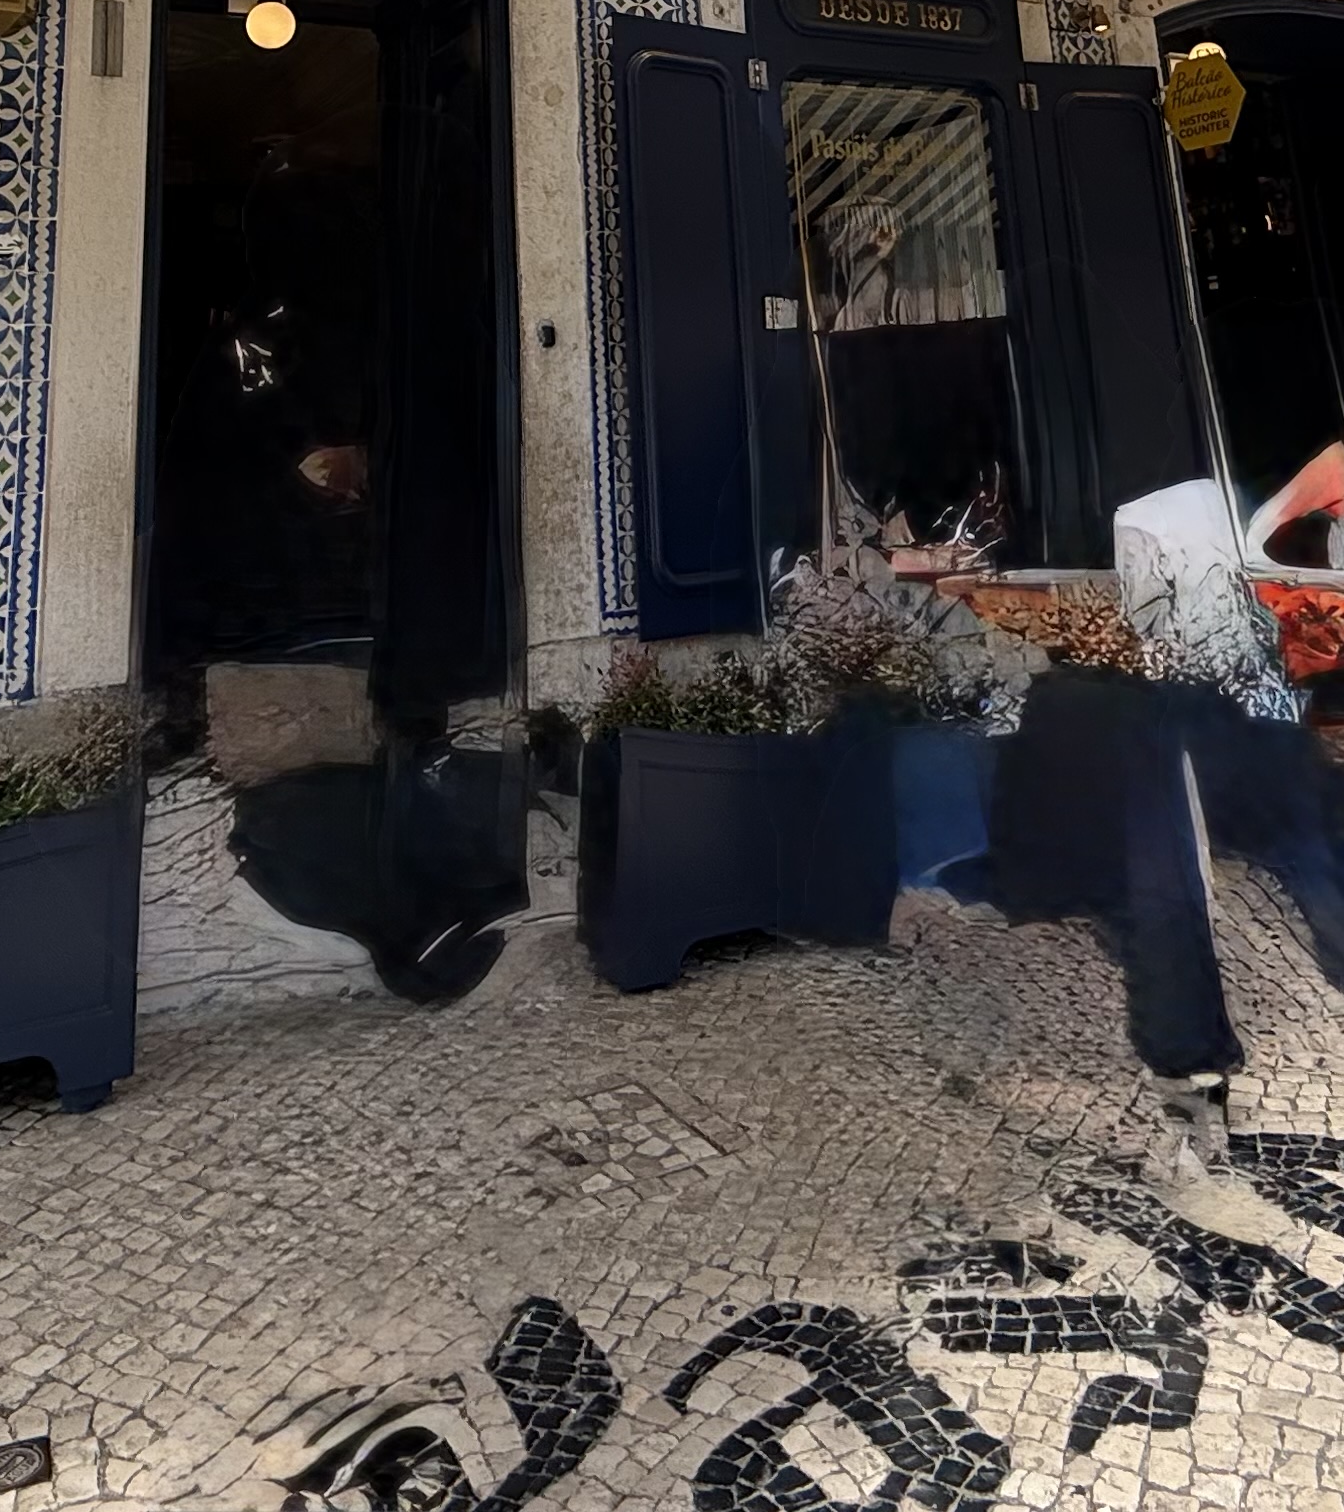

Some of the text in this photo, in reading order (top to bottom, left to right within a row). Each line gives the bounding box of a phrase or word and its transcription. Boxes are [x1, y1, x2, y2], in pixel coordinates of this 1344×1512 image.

[916, 2, 963, 32] 1837
[1175, 67, 1224, 93] Balcão
[1170, 85, 1233, 110] Histórico
[1178, 107, 1228, 128] HISTORIC
[1178, 119, 1231, 139] COUNTER
